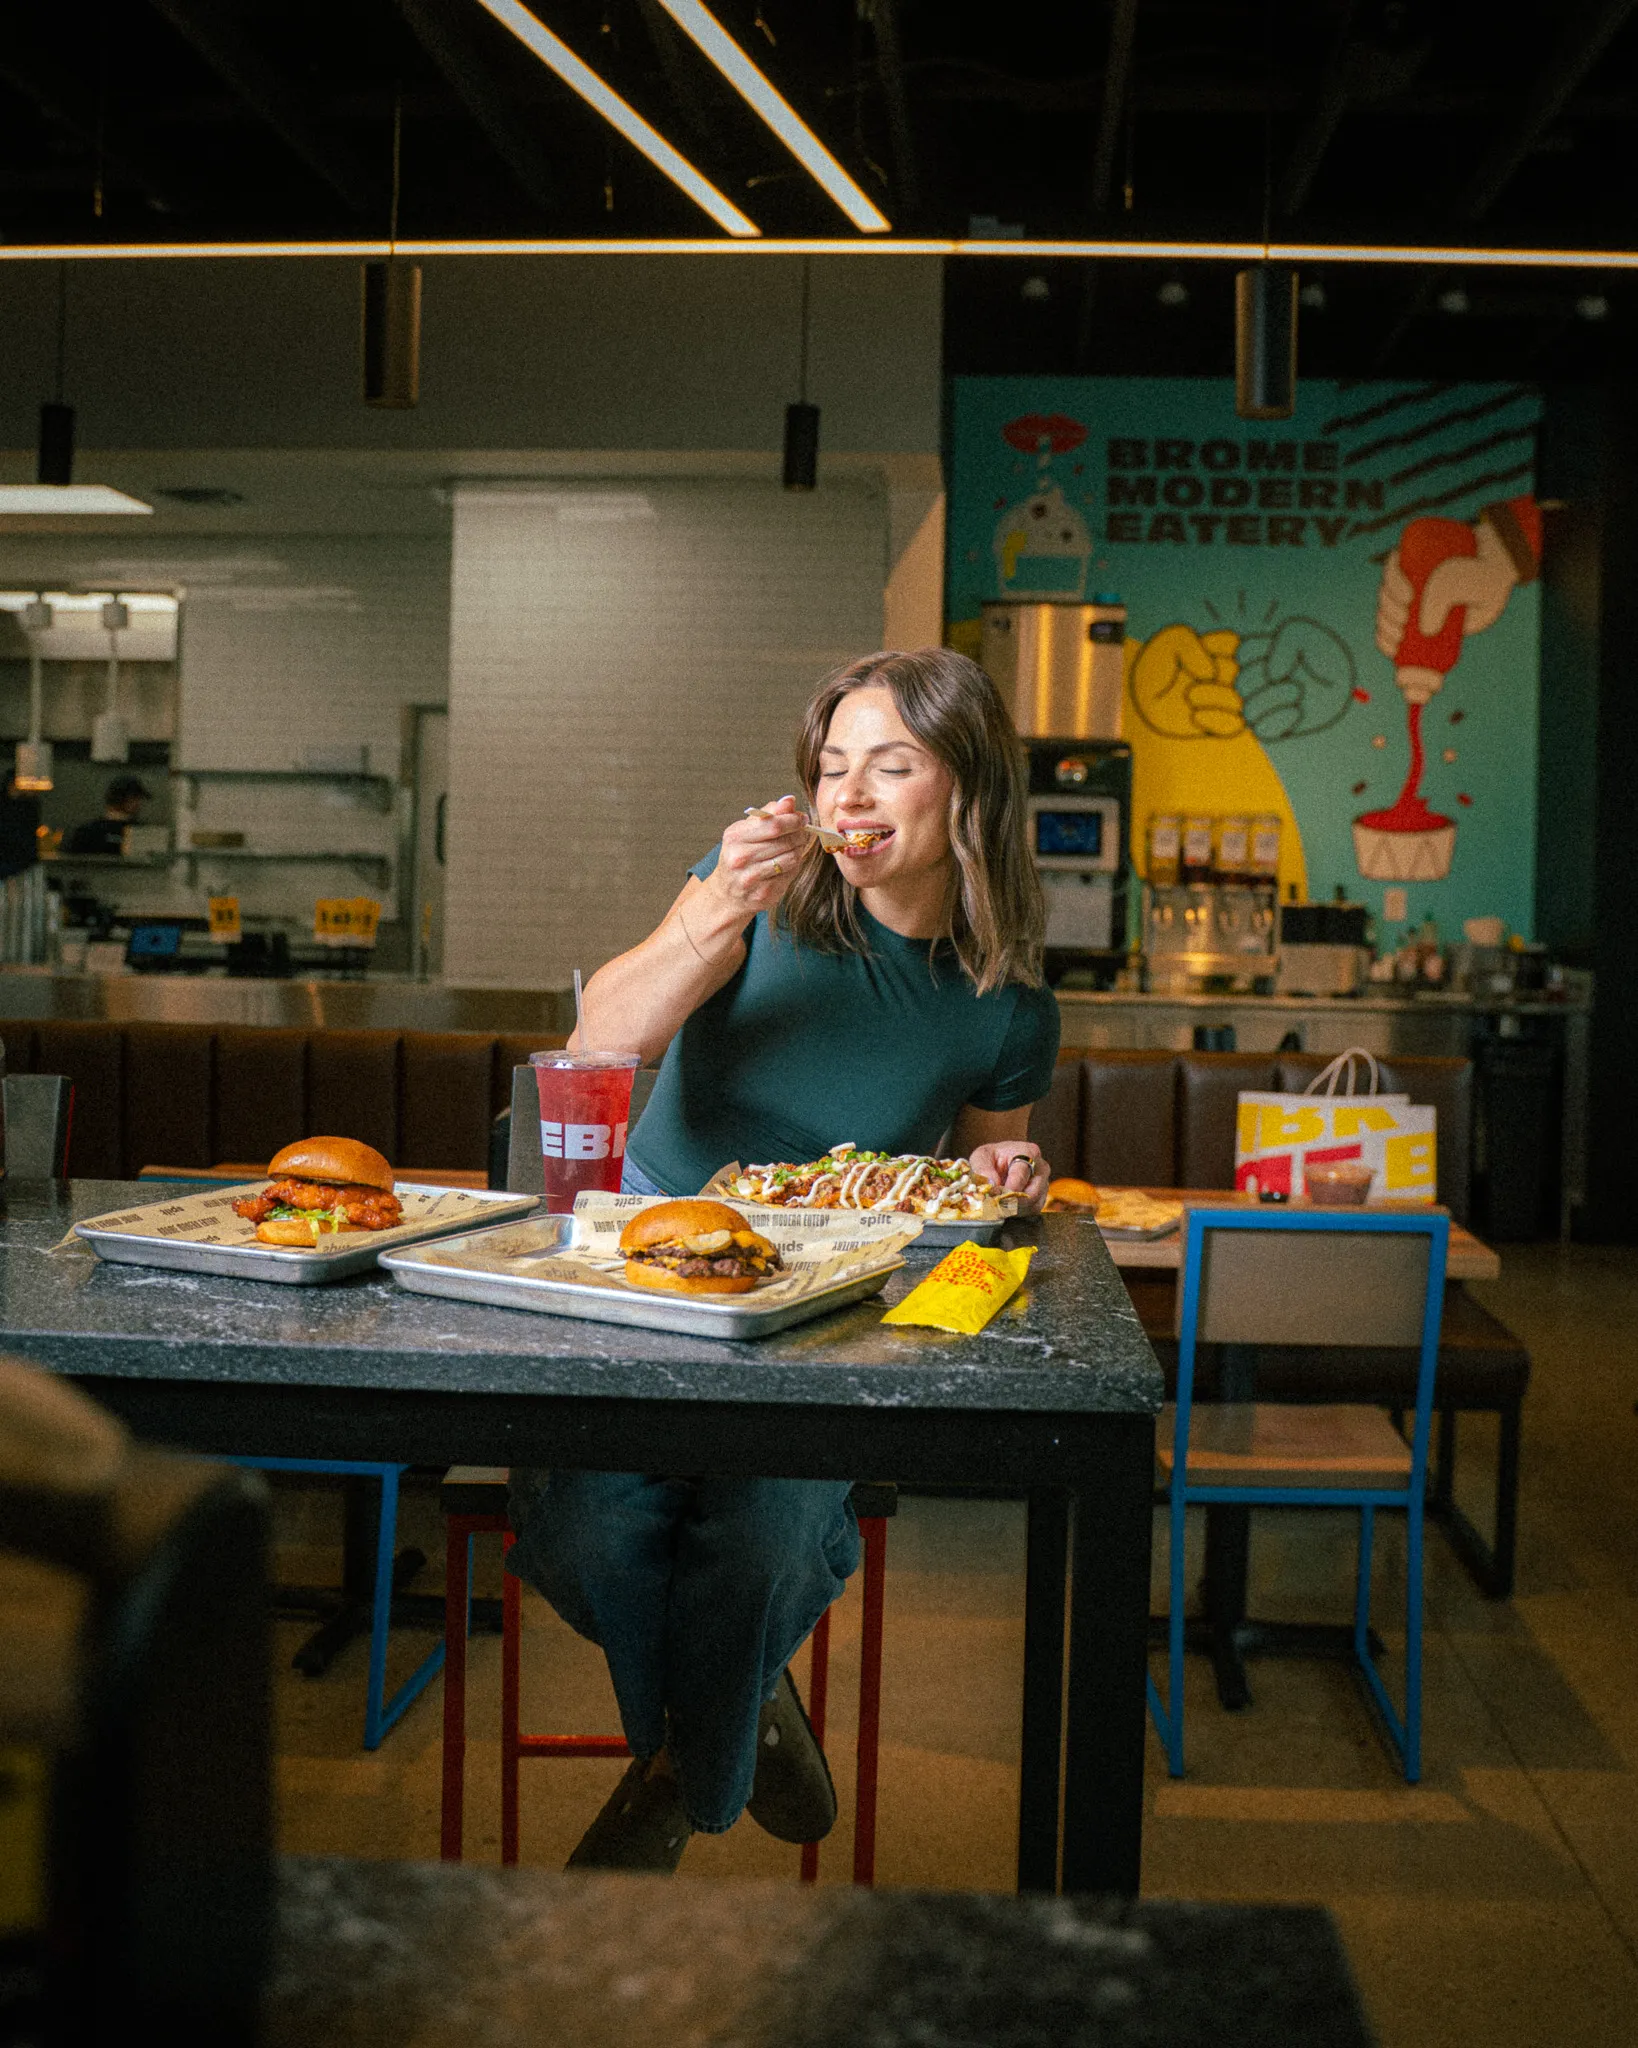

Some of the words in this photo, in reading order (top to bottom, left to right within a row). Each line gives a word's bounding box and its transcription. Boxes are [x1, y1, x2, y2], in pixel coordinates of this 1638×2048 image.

[1106, 437, 1340, 472] BROME
[1106, 475, 1385, 510] MODERN
[1106, 511, 1349, 546] EATERY
